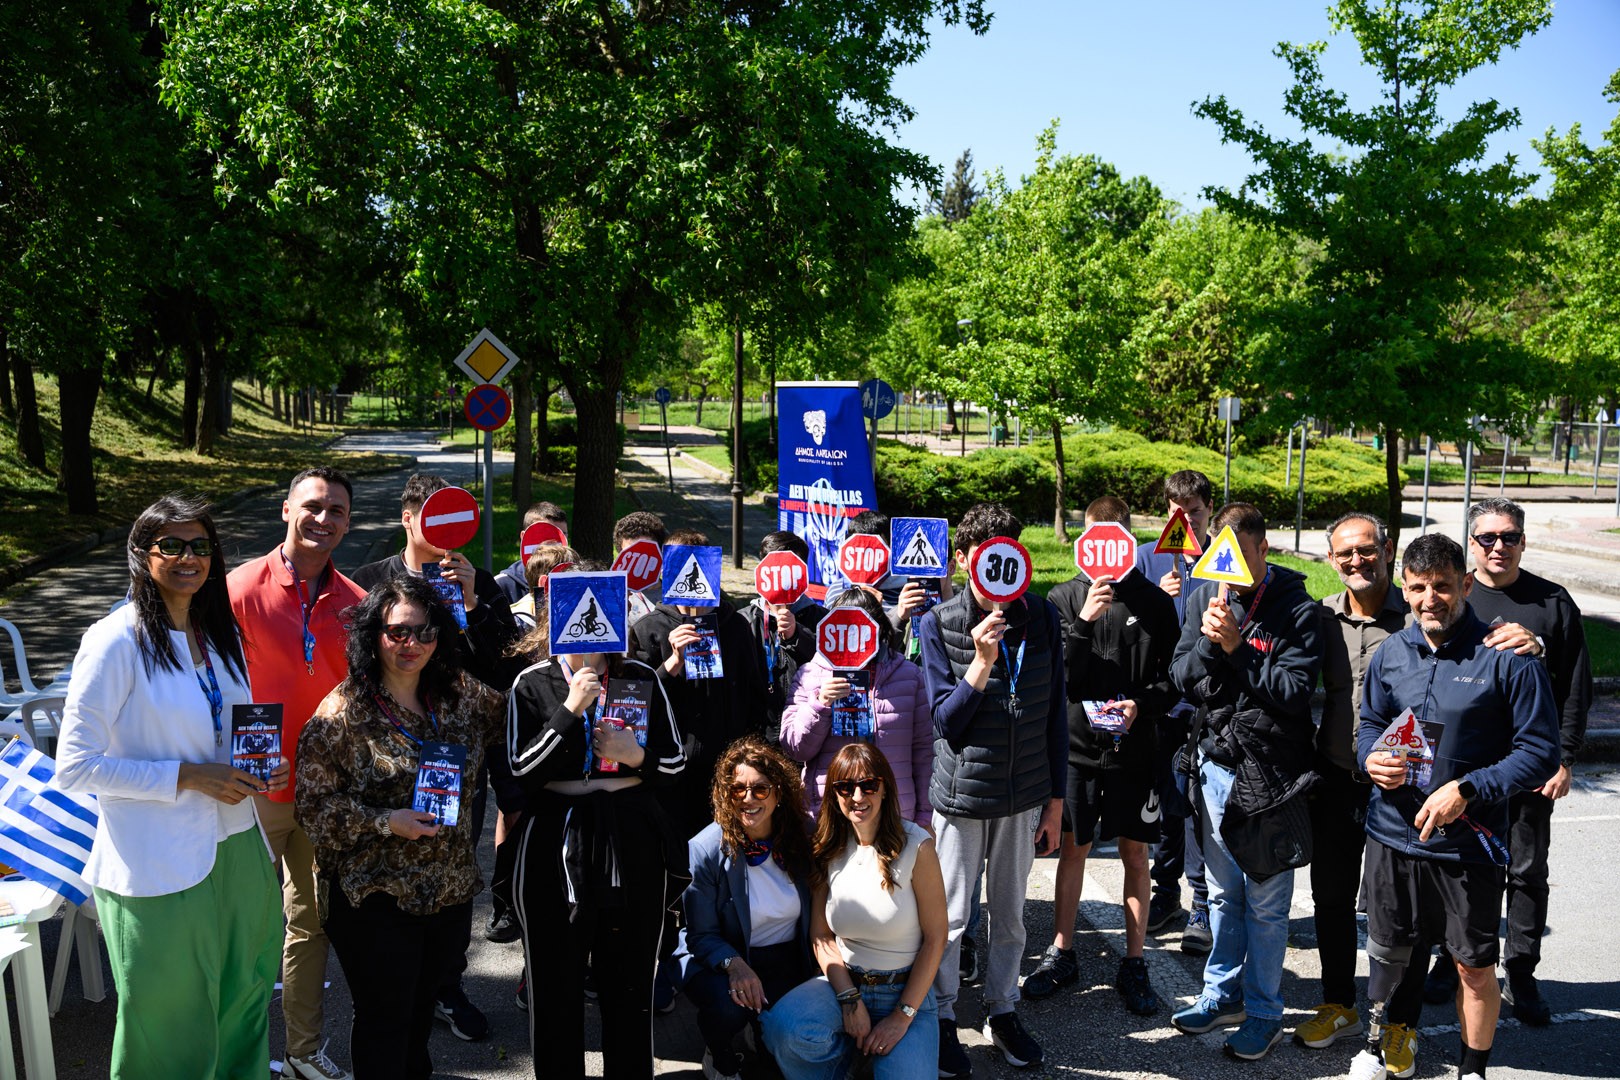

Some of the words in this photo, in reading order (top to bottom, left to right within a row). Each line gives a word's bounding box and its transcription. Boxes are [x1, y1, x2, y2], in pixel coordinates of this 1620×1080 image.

[617, 551, 658, 580] STOP
[844, 546, 884, 572] STOP
[1083, 539, 1128, 567] STOP
[760, 564, 802, 592] STOP
[986, 552, 1018, 585] 30
[824, 624, 871, 652] STOP
